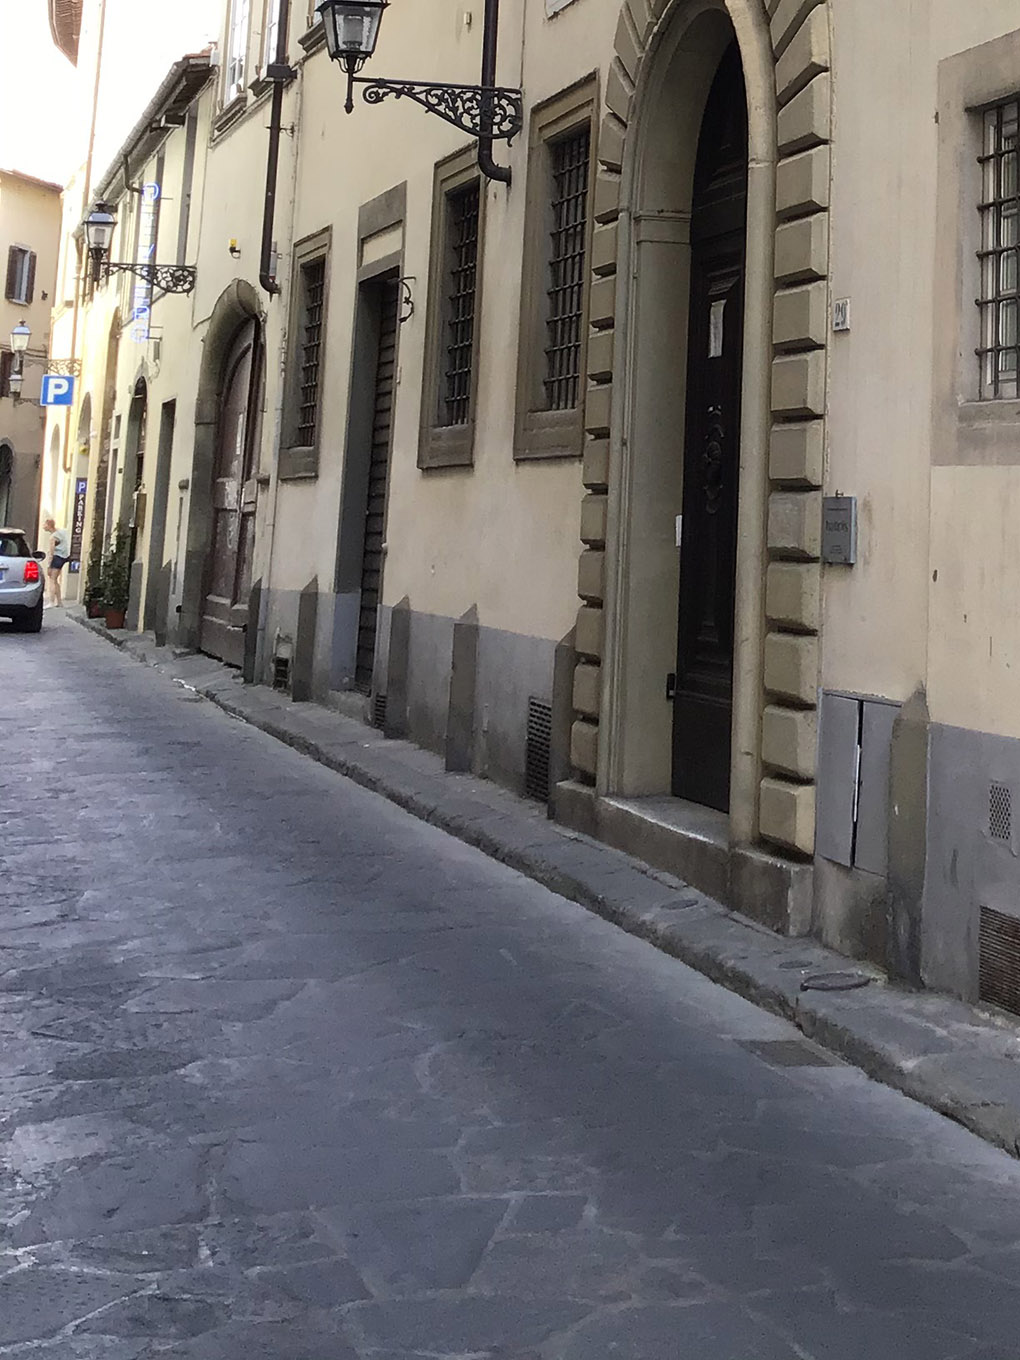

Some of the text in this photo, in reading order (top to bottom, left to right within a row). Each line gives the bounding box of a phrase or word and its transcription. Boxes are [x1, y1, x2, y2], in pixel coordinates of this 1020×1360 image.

[47, 378, 69, 403] P
[78, 482, 86, 492] P
[75, 494, 84, 533] PARKING
